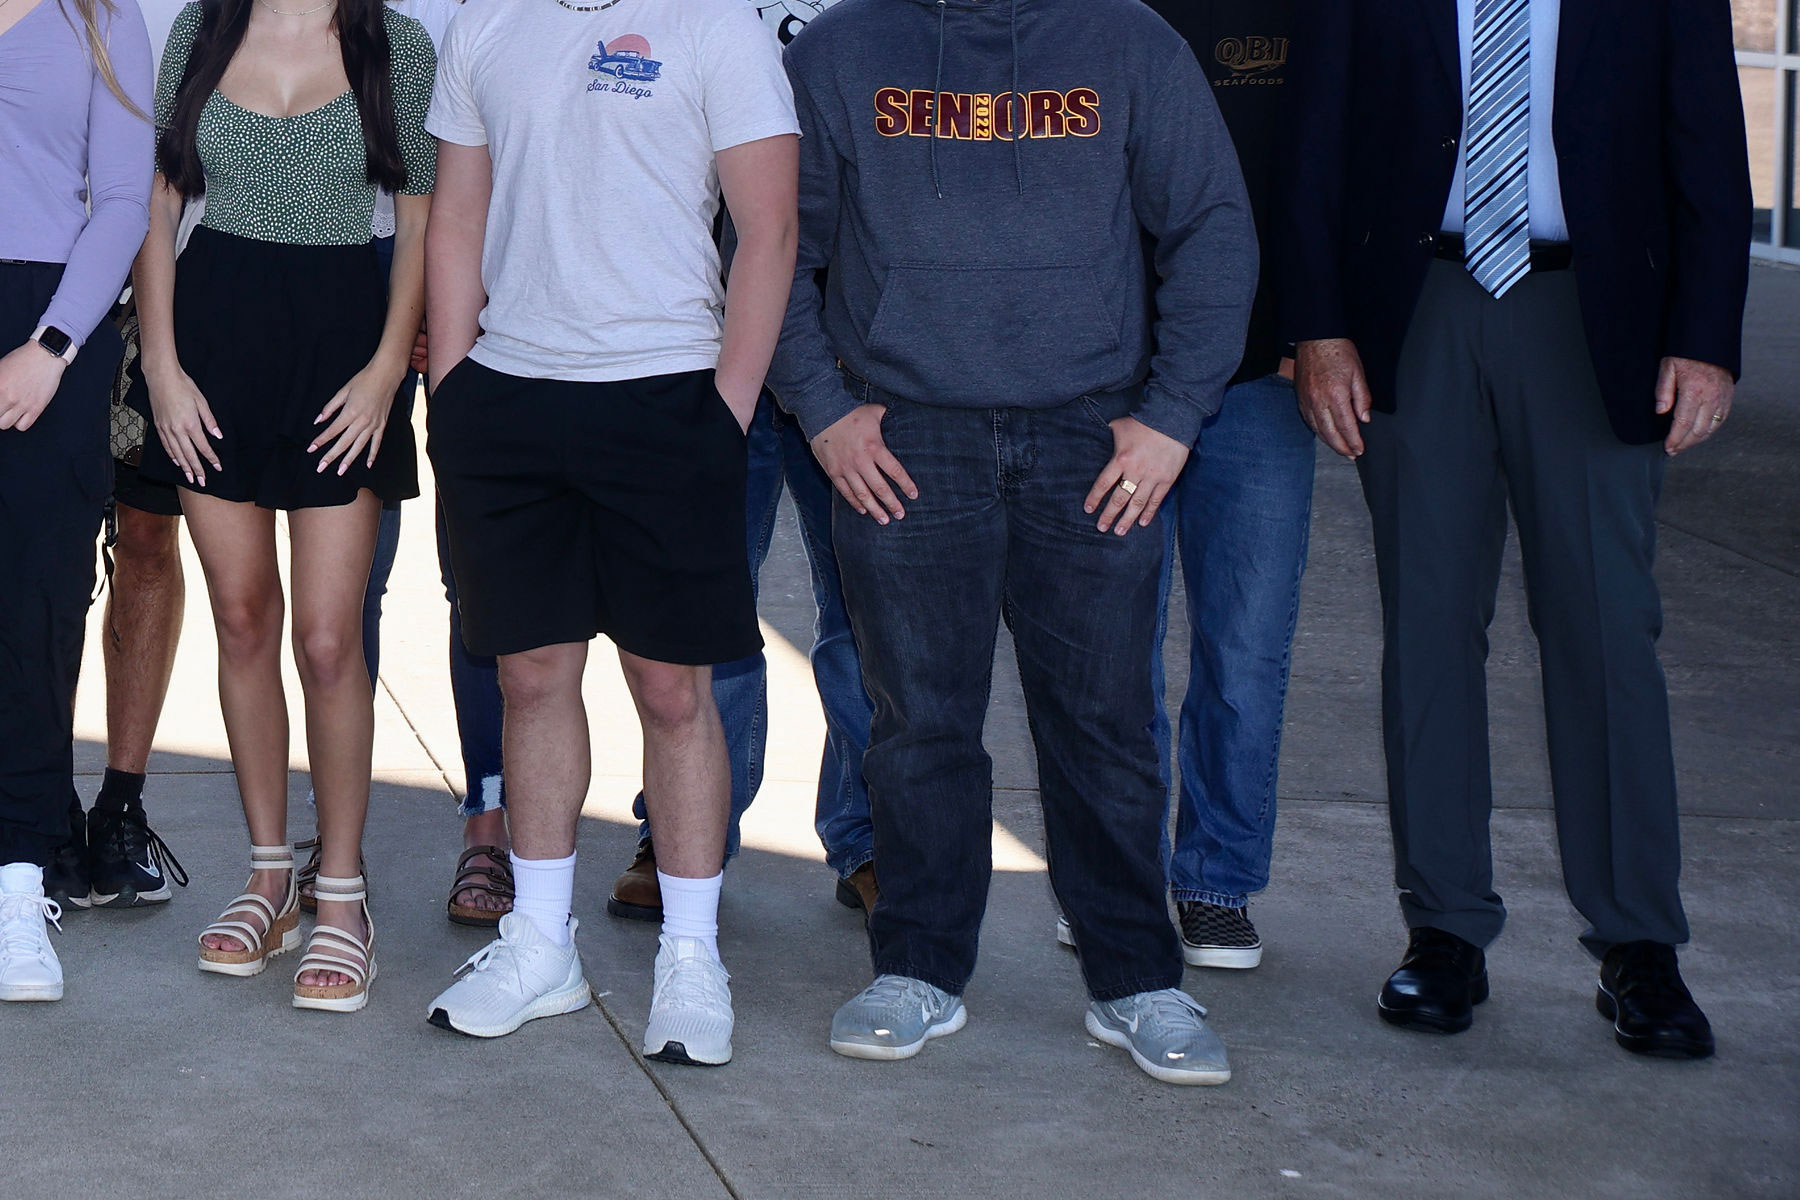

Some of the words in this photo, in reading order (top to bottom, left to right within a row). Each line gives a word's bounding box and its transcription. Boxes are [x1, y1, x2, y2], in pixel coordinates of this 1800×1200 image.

[586, 79, 609, 94] San
[611, 81, 653, 100] Diego
[1214, 78, 1284, 87] SEAFOODS
[976, 96, 990, 138] 2022
